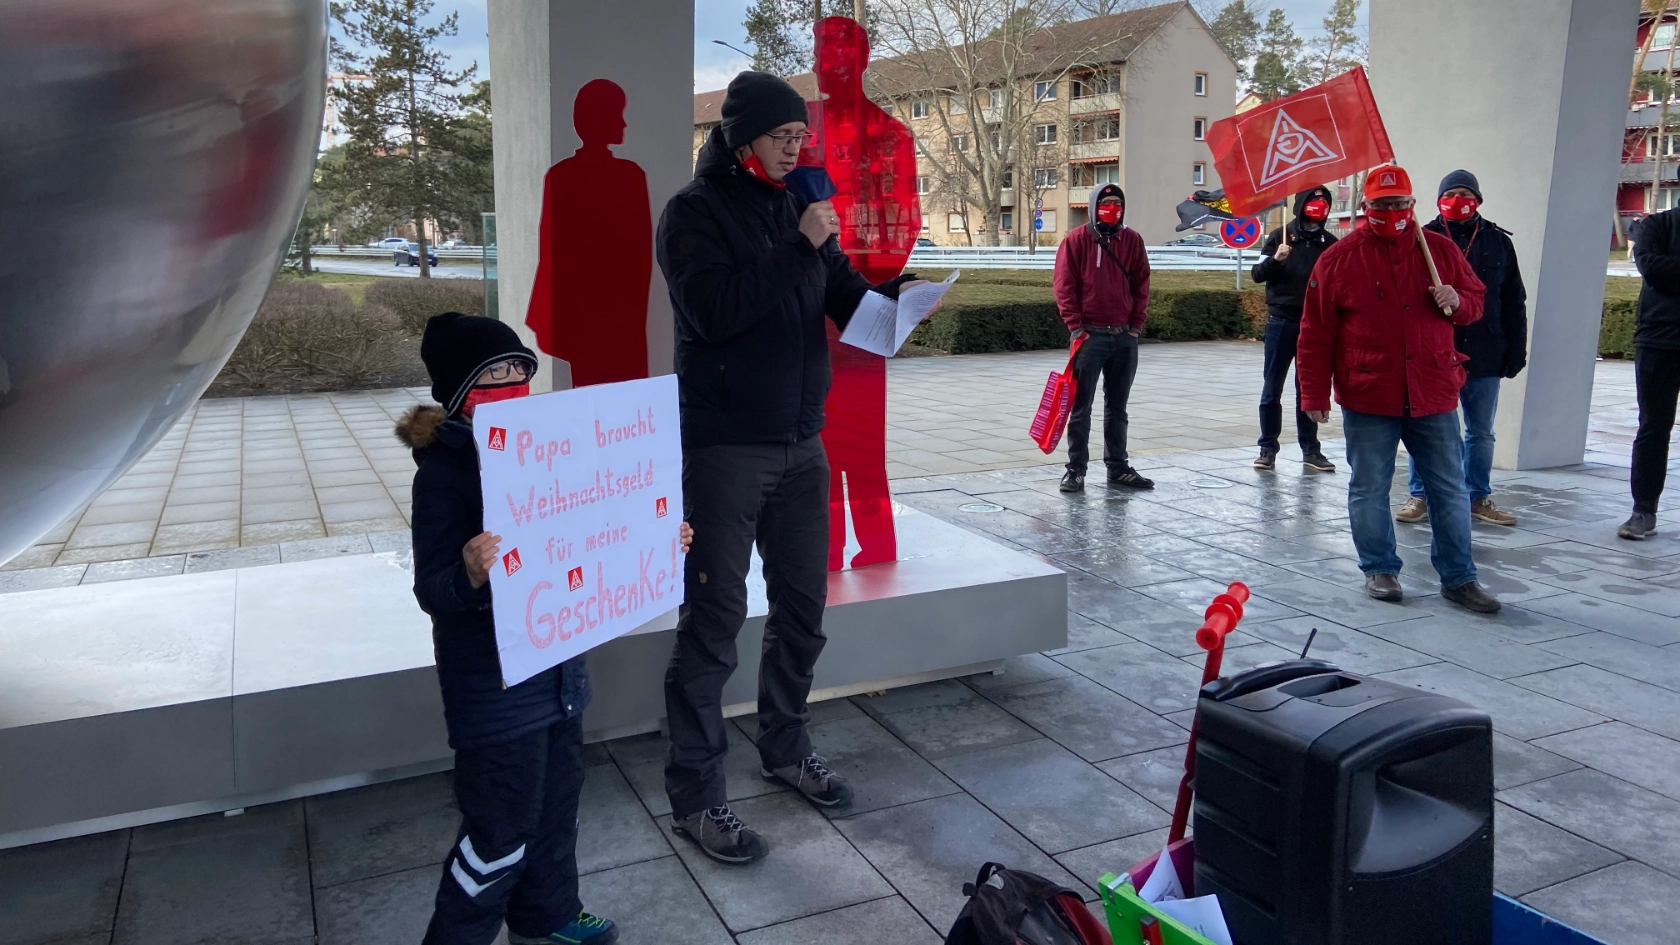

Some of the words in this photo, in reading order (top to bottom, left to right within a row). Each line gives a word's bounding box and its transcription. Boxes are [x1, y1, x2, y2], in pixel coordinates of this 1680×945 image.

[516, 429, 571, 471] Papa
[595, 407, 656, 448] braucht
[507, 458, 654, 527] Weihnachtsgeld
[546, 538, 573, 565] für
[586, 523, 628, 552] meine
